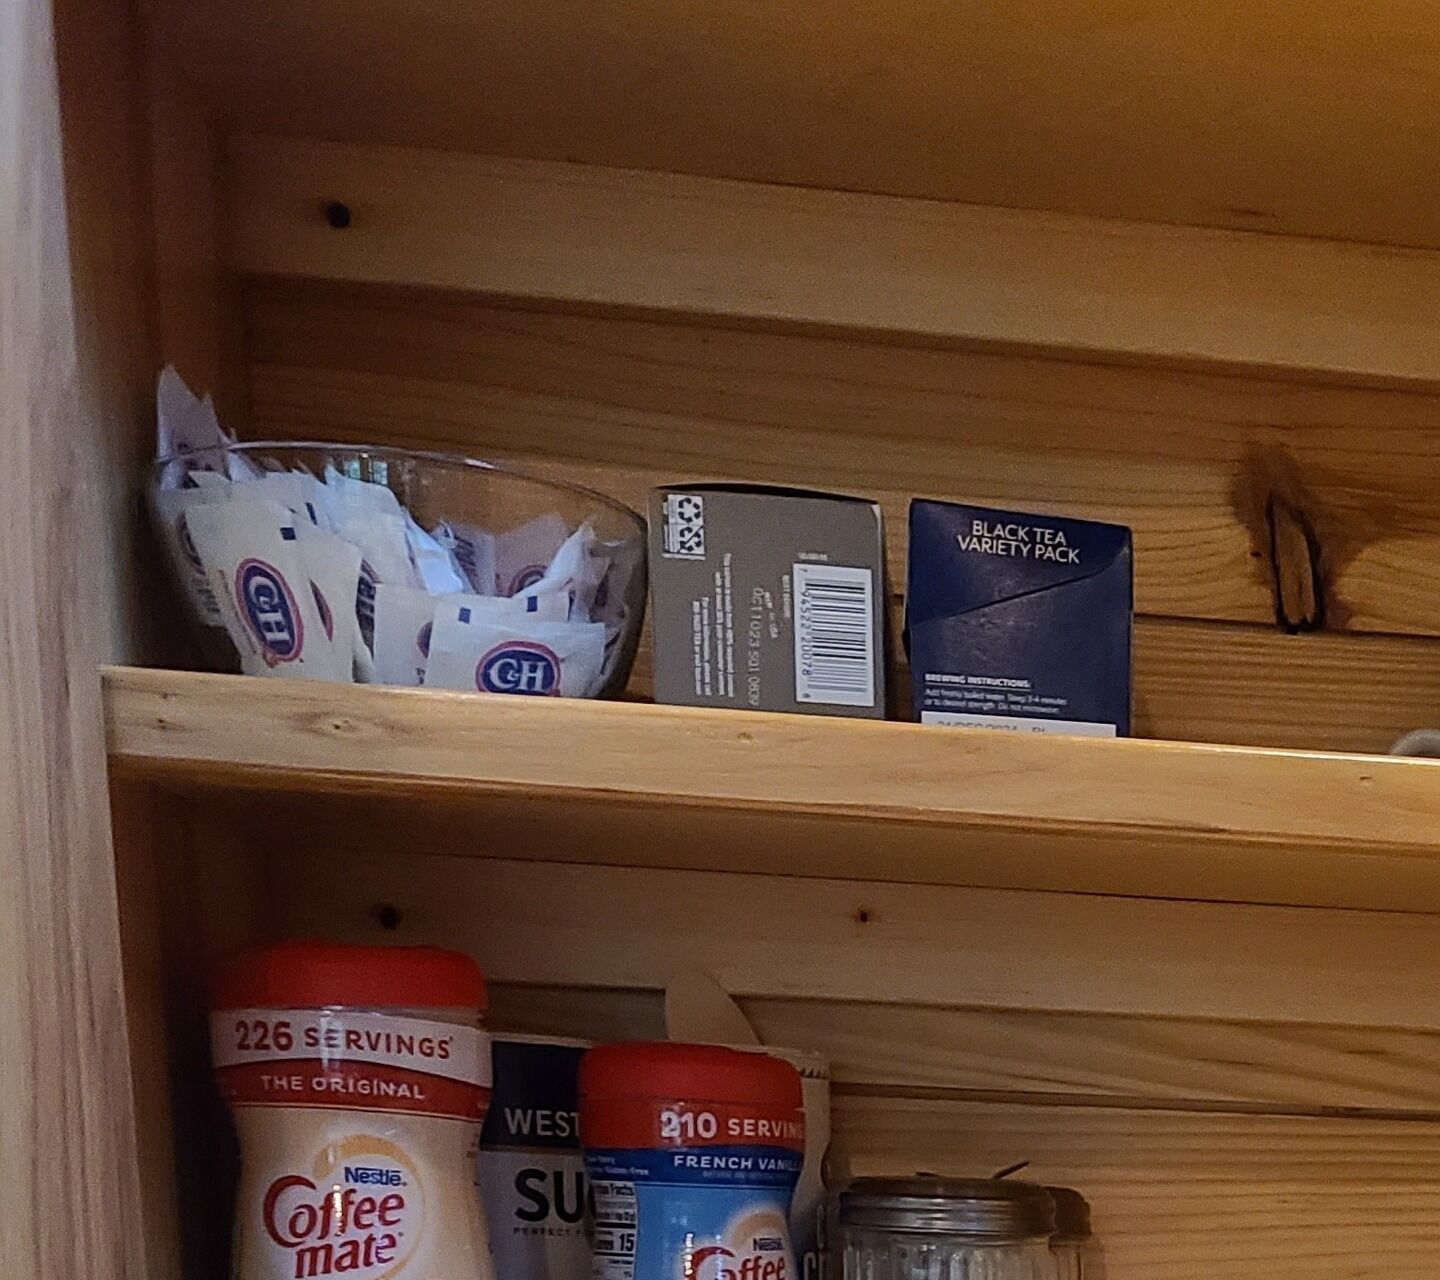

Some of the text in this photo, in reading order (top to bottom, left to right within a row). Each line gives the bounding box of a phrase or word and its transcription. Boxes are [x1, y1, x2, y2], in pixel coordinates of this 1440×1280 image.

[972, 519, 1067, 546] BLACK TEA
[956, 534, 1080, 564] VARIETY PACK
[235, 1020, 294, 1052] 226
[260, 1075, 426, 1100] THE ORIGINAL
[659, 1110, 718, 1139] 210
[673, 1154, 753, 1170] FRENCH
[263, 1174, 405, 1249] Coffee
[294, 1232, 398, 1279] mate
[619, 1233, 635, 1252] 15
